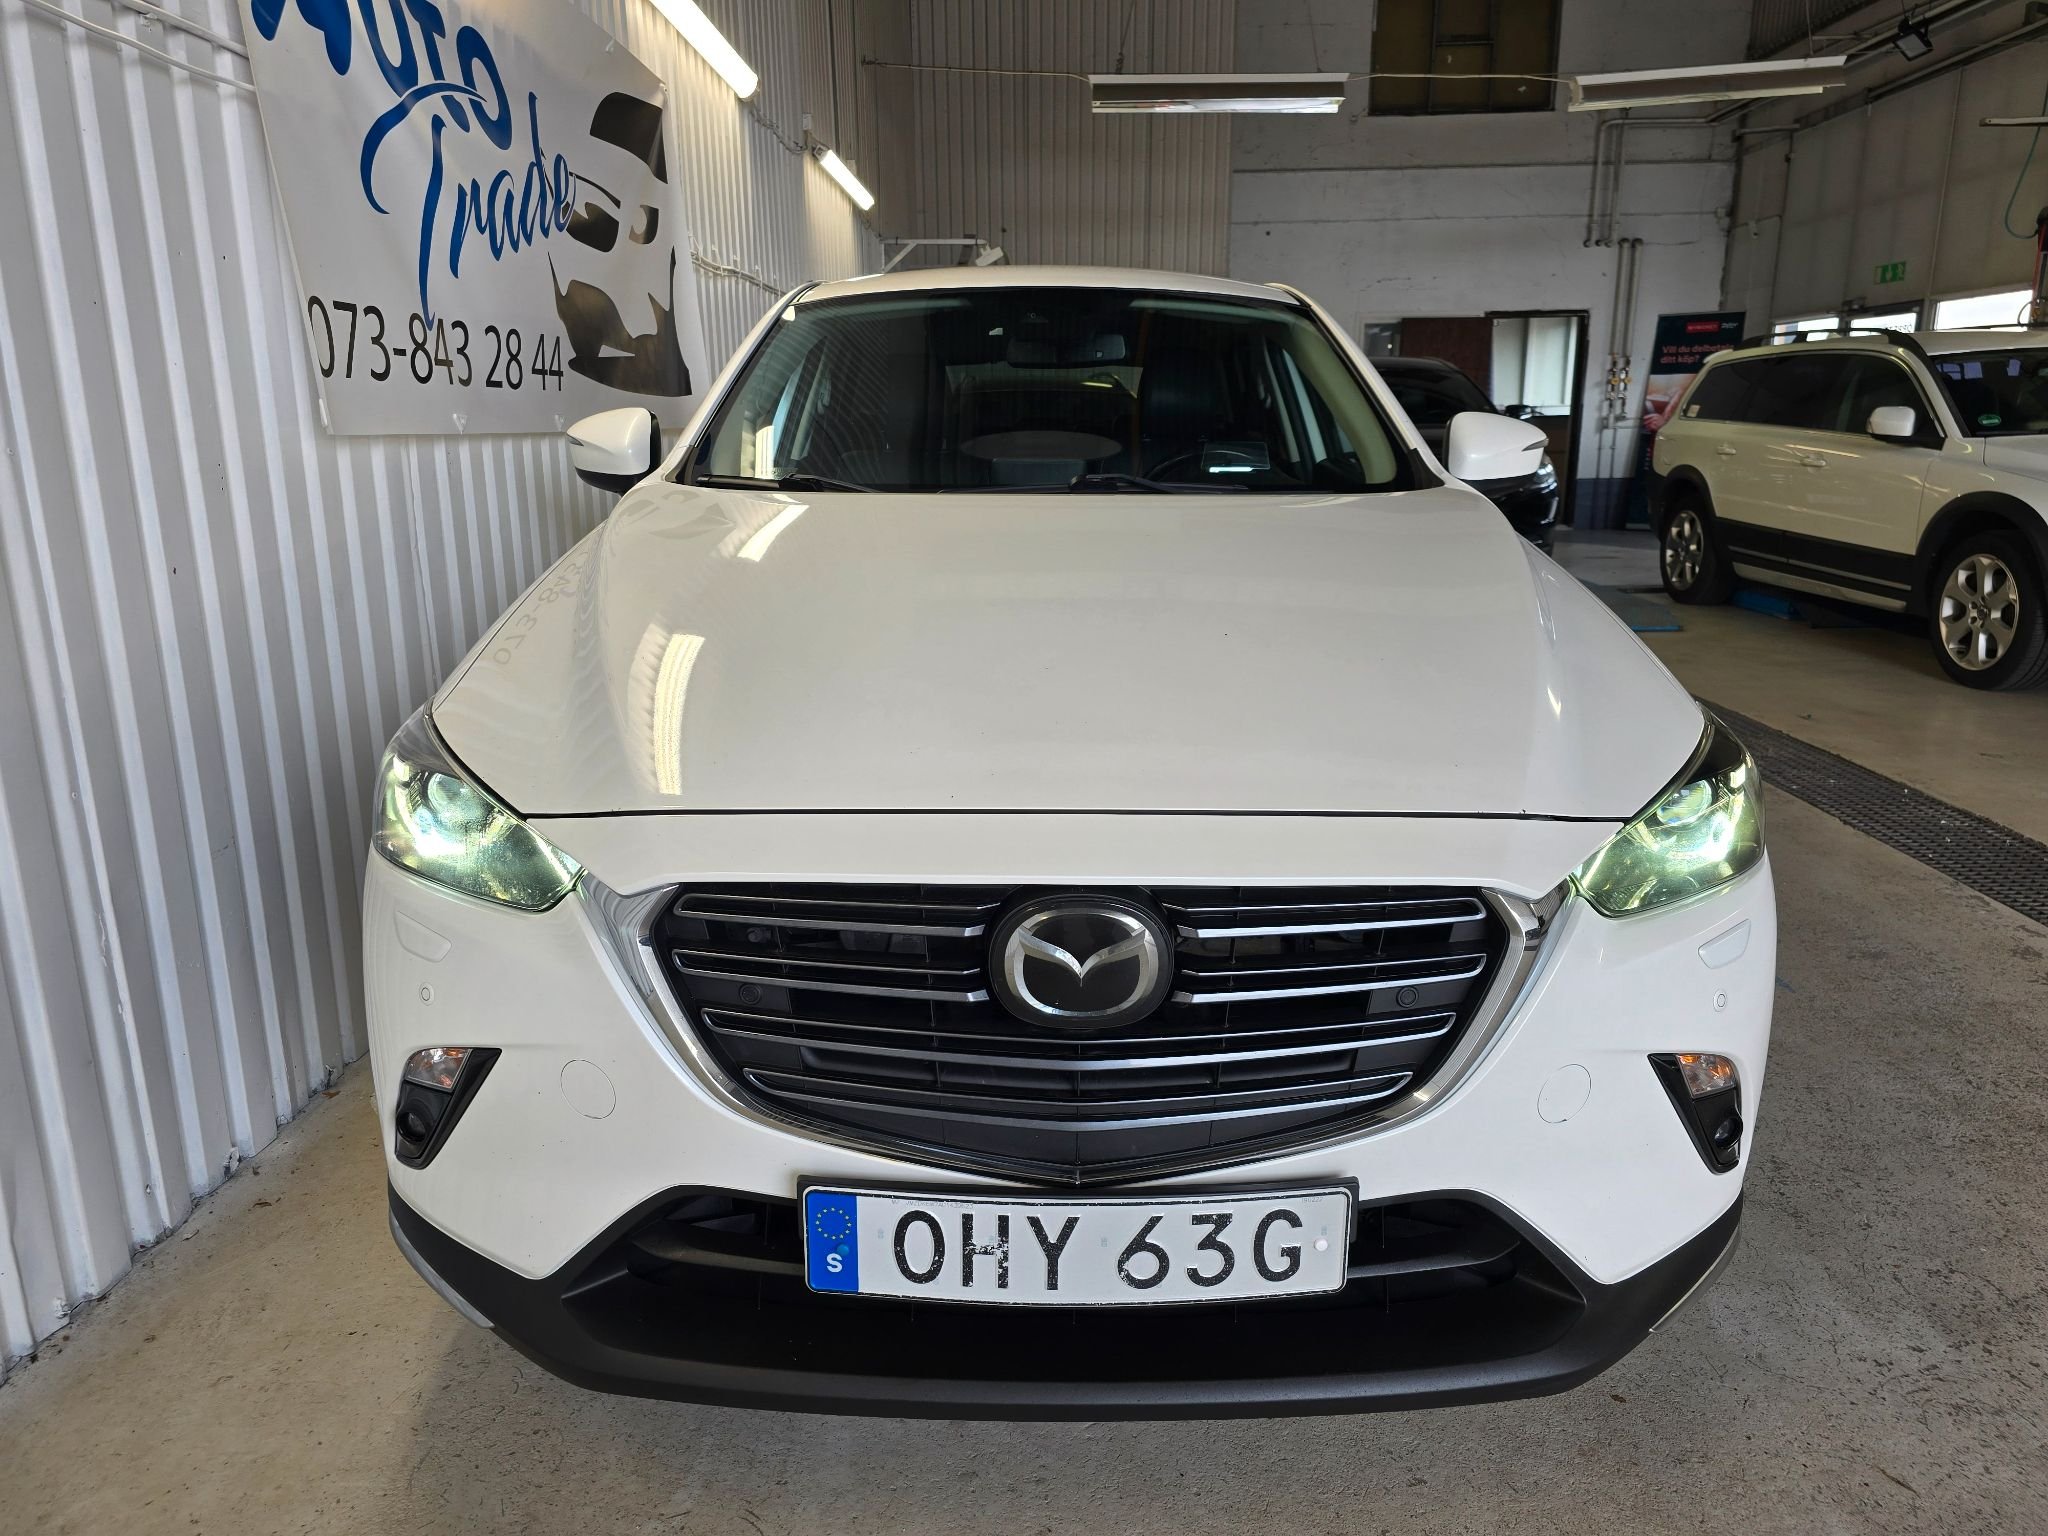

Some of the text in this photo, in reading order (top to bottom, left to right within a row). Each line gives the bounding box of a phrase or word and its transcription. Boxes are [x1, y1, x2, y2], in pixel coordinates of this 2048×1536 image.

[360, 82, 577, 331] Trade
[308, 296, 564, 392] 073-843 28 44
[1678, 345, 1690, 353] du
[826, 1253, 843, 1273] S
[893, 1208, 1303, 1291] OHY 63G
